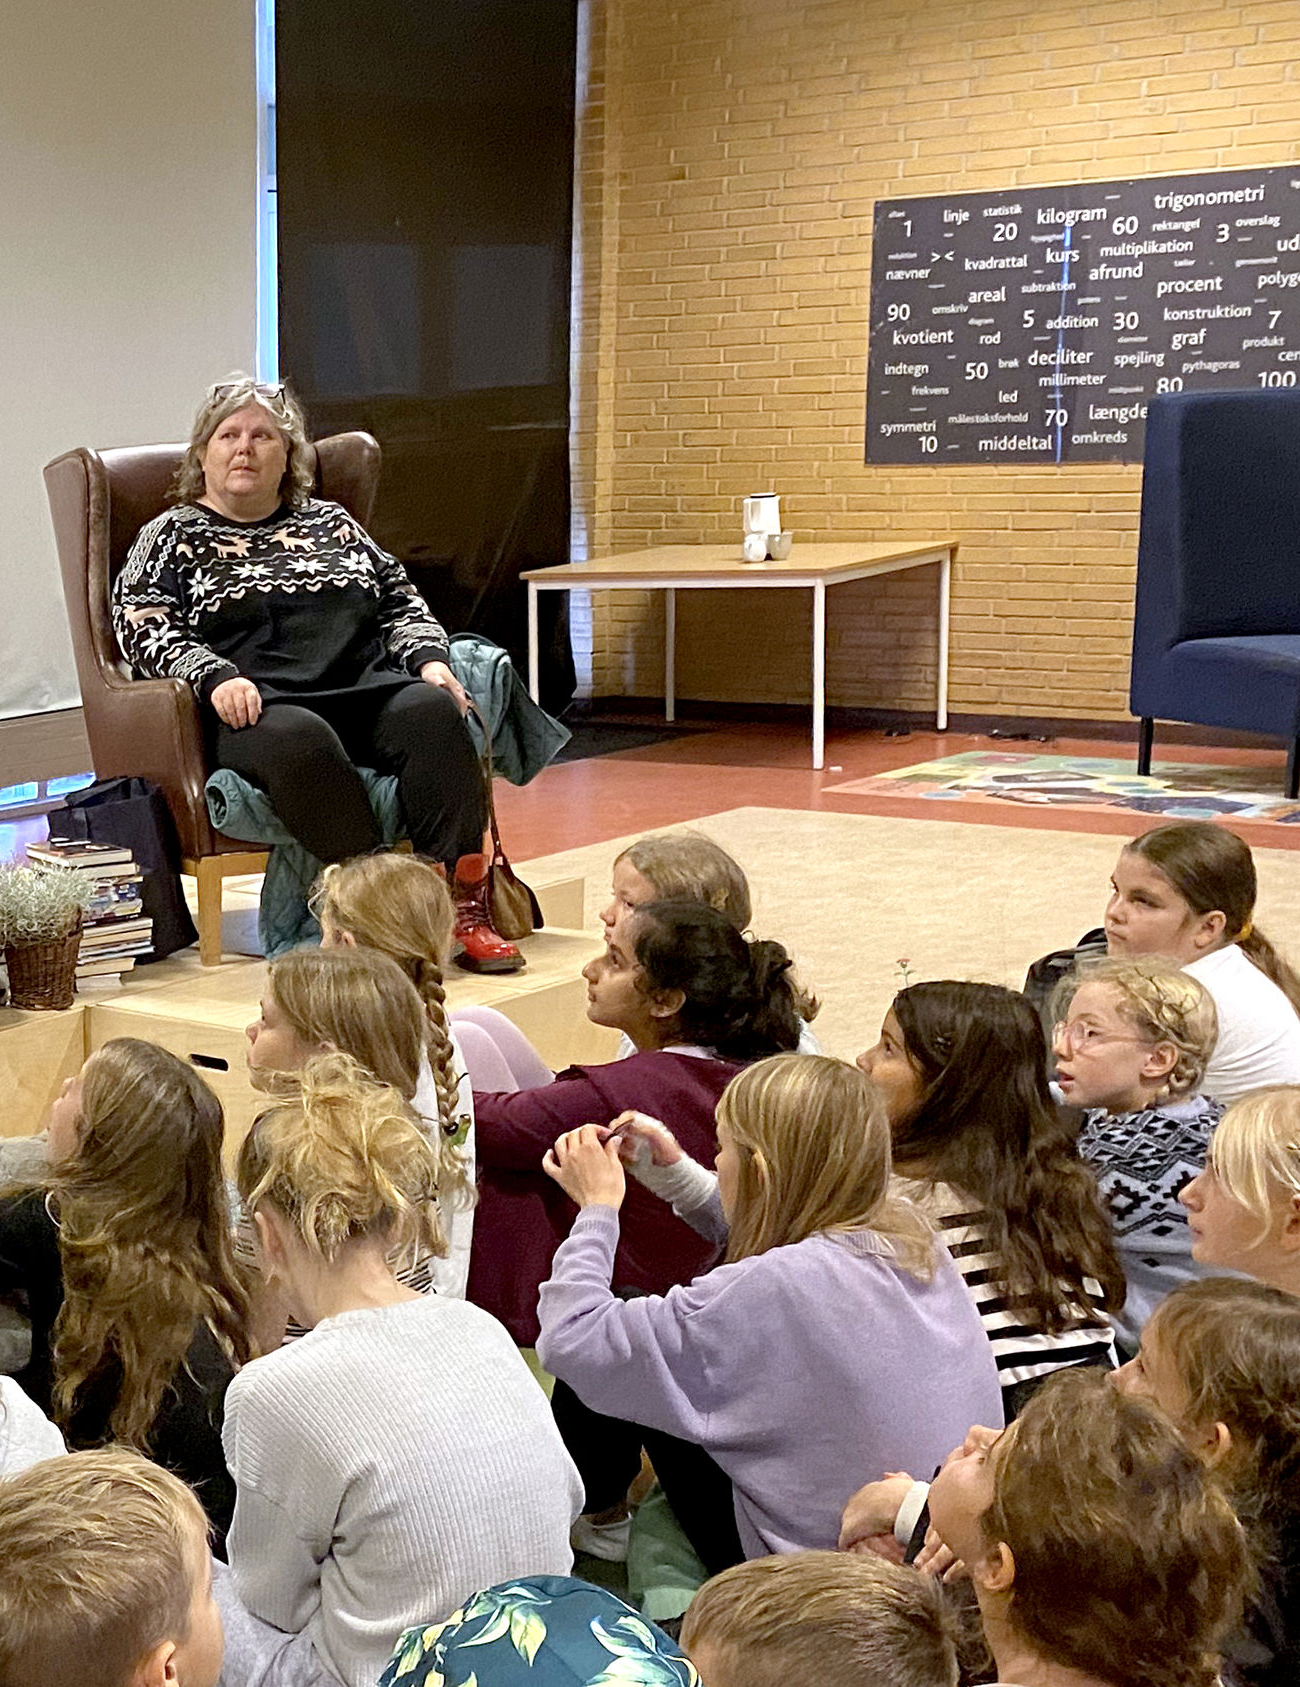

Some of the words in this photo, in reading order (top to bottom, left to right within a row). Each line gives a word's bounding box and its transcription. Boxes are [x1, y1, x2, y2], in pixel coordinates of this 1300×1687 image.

[1153, 184, 1265, 212] trigonometri
[943, 209, 969, 225] linje
[982, 204, 1022, 217] statistik
[1036, 207, 1107, 227] kilogram
[903, 220, 911, 237] 1
[1112, 216, 1138, 235] 60
[1235, 214, 1280, 227] overslag
[992, 222, 1017, 241] 20
[1216, 223, 1229, 242] 3
[1045, 247, 1079, 263] kurs
[1100, 239, 1193, 258] multiplikation
[964, 254, 1027, 270] kvadrattal
[1089, 261, 1143, 280] afrund
[886, 268, 931, 280] nævner
[968, 286, 1006, 303] areal
[1157, 275, 1223, 298] procent
[887, 303, 910, 321] 90
[1022, 309, 1034, 327] 5
[1112, 311, 1139, 330] 30
[1163, 304, 1251, 320] konstruktion
[1268, 310, 1281, 329] 7
[1046, 315, 1098, 329] addition
[892, 329, 953, 345] kvotient
[979, 330, 1000, 344] rod
[1171, 328, 1206, 350] graf
[1242, 335, 1284, 350] produkt
[1027, 349, 1093, 365] deciliter
[1113, 351, 1164, 368] spejling
[884, 362, 928, 377] indtegn
[964, 362, 988, 379] 50
[1181, 360, 1240, 373] pythagoras
[1038, 373, 1106, 386] millimeter
[1156, 376, 1183, 394] 80
[1257, 370, 1296, 387] 100
[911, 385, 948, 395] frekvens
[998, 390, 1017, 402] led
[1045, 408, 1068, 427] 70
[1088, 403, 1147, 423] længde
[880, 419, 936, 436] symmetri
[918, 436, 937, 452] 10
[978, 434, 1052, 451] middeltal
[1071, 430, 1127, 444] omkreds
